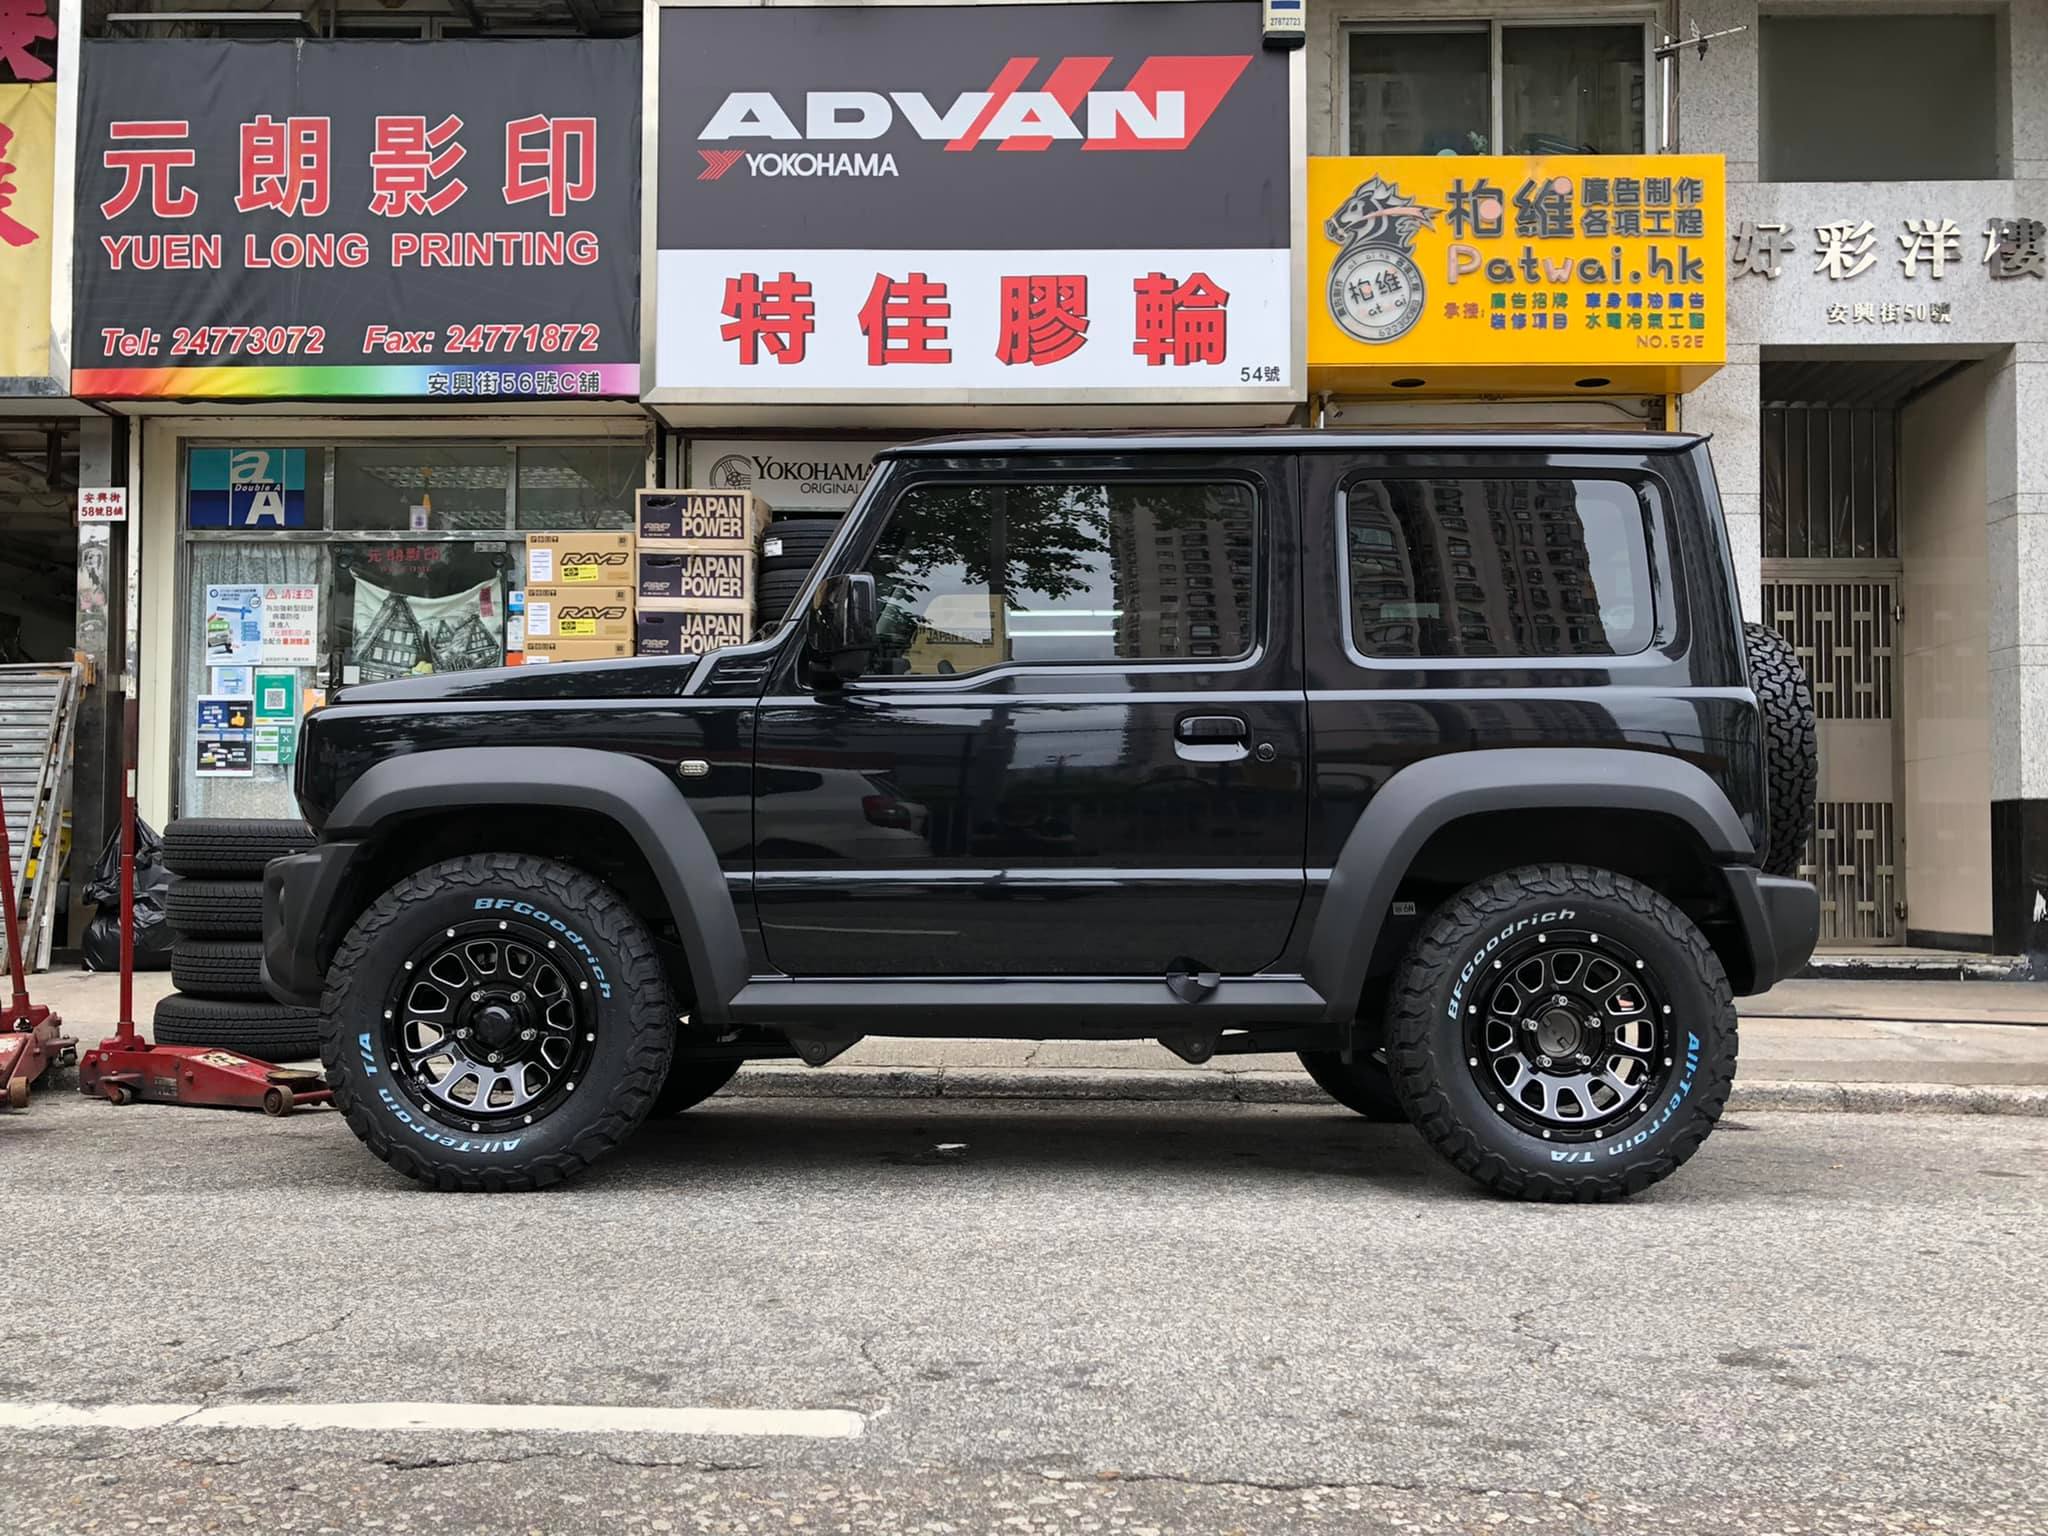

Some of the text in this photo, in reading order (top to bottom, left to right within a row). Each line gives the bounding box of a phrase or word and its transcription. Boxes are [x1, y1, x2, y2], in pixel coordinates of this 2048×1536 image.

[697, 91, 1185, 140] ADVAN
[100, 113, 598, 219] 元朗影印
[745, 152, 899, 177] YOKOHAMA
[1581, 176, 1704, 207] 廣告制作
[1581, 209, 1704, 238] 各項工程
[100, 231, 600, 270] YUEN LONG PRINTING
[1732, 217, 2047, 281] 好彩洋樓
[1447, 244, 1704, 284] Patwai.hk
[720, 271, 1230, 367] 特佳膠輪
[1827, 303, 1952, 325] 安興街50號
[101, 324, 600, 357] Tel: 24773072 Fax: 24771872
[1636, 334, 1704, 349] NO.52E
[427, 371, 601, 394] 安興街56號C舖
[1240, 366, 1281, 383] 54號
[234, 483, 272, 492] Double
[681, 497, 742, 518] JAPAN
[681, 517, 743, 537] POWER
[560, 552, 629, 566] RAYS
[681, 556, 742, 577] JAPAN
[680, 577, 742, 598] POWER
[558, 606, 627, 620] RAYS
[680, 615, 741, 636] JAPAN
[474, 897, 611, 998] BFGoodrich
[1447, 908, 1576, 1020] BFGoodrich
[1608, 1031, 1701, 1157] All-Terrain
[378, 1087, 522, 1153] All-Terrain
